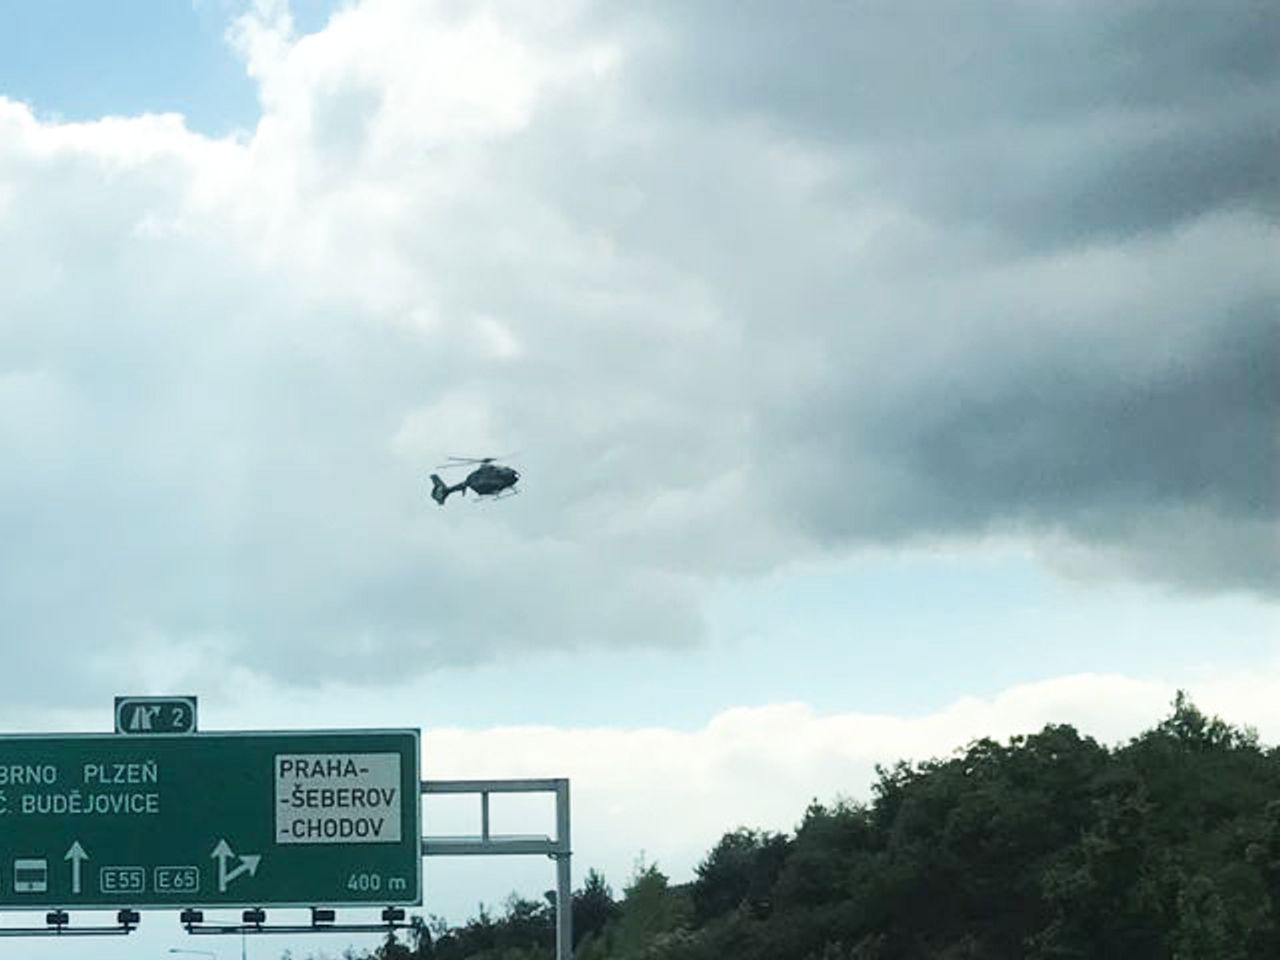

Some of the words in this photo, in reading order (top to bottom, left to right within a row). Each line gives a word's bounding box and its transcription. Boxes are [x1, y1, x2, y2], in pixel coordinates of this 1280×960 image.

[172, 708, 184, 727] 2
[84, 760, 158, 784] PLZEŇ
[279, 759, 369, 778] PRAHA-
[22, 790, 159, 814] BUDĚJOVICE
[279, 783, 396, 808] -ŠEBEROV
[280, 817, 384, 838] -CHODOV
[347, 873, 381, 890] 400
[388, 876, 406, 890] m
